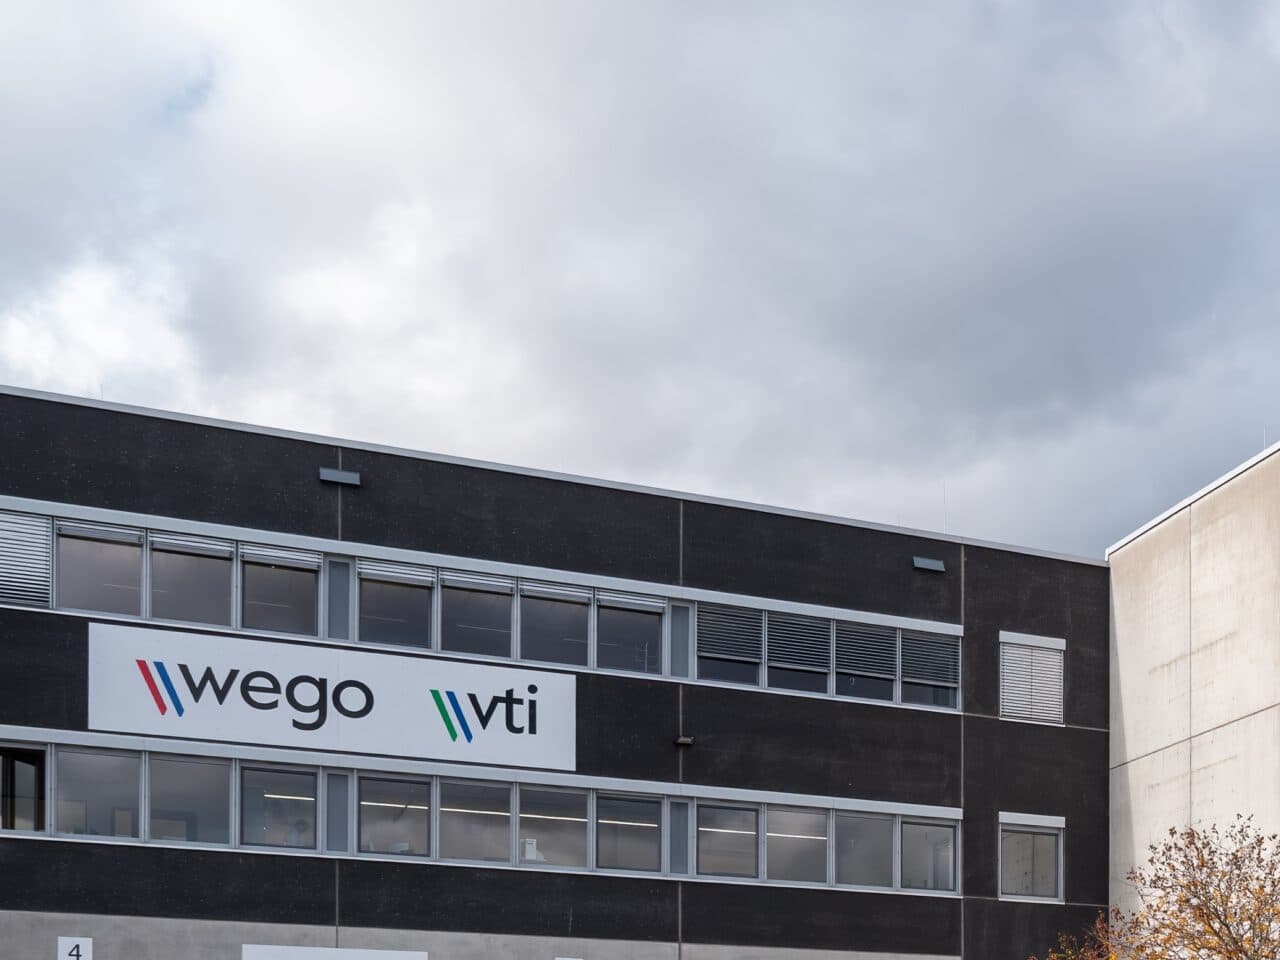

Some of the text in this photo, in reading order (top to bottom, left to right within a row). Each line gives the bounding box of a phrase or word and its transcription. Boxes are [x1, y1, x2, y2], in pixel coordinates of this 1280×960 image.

[177, 663, 539, 736] wego vti
[68, 943, 83, 960] 4
